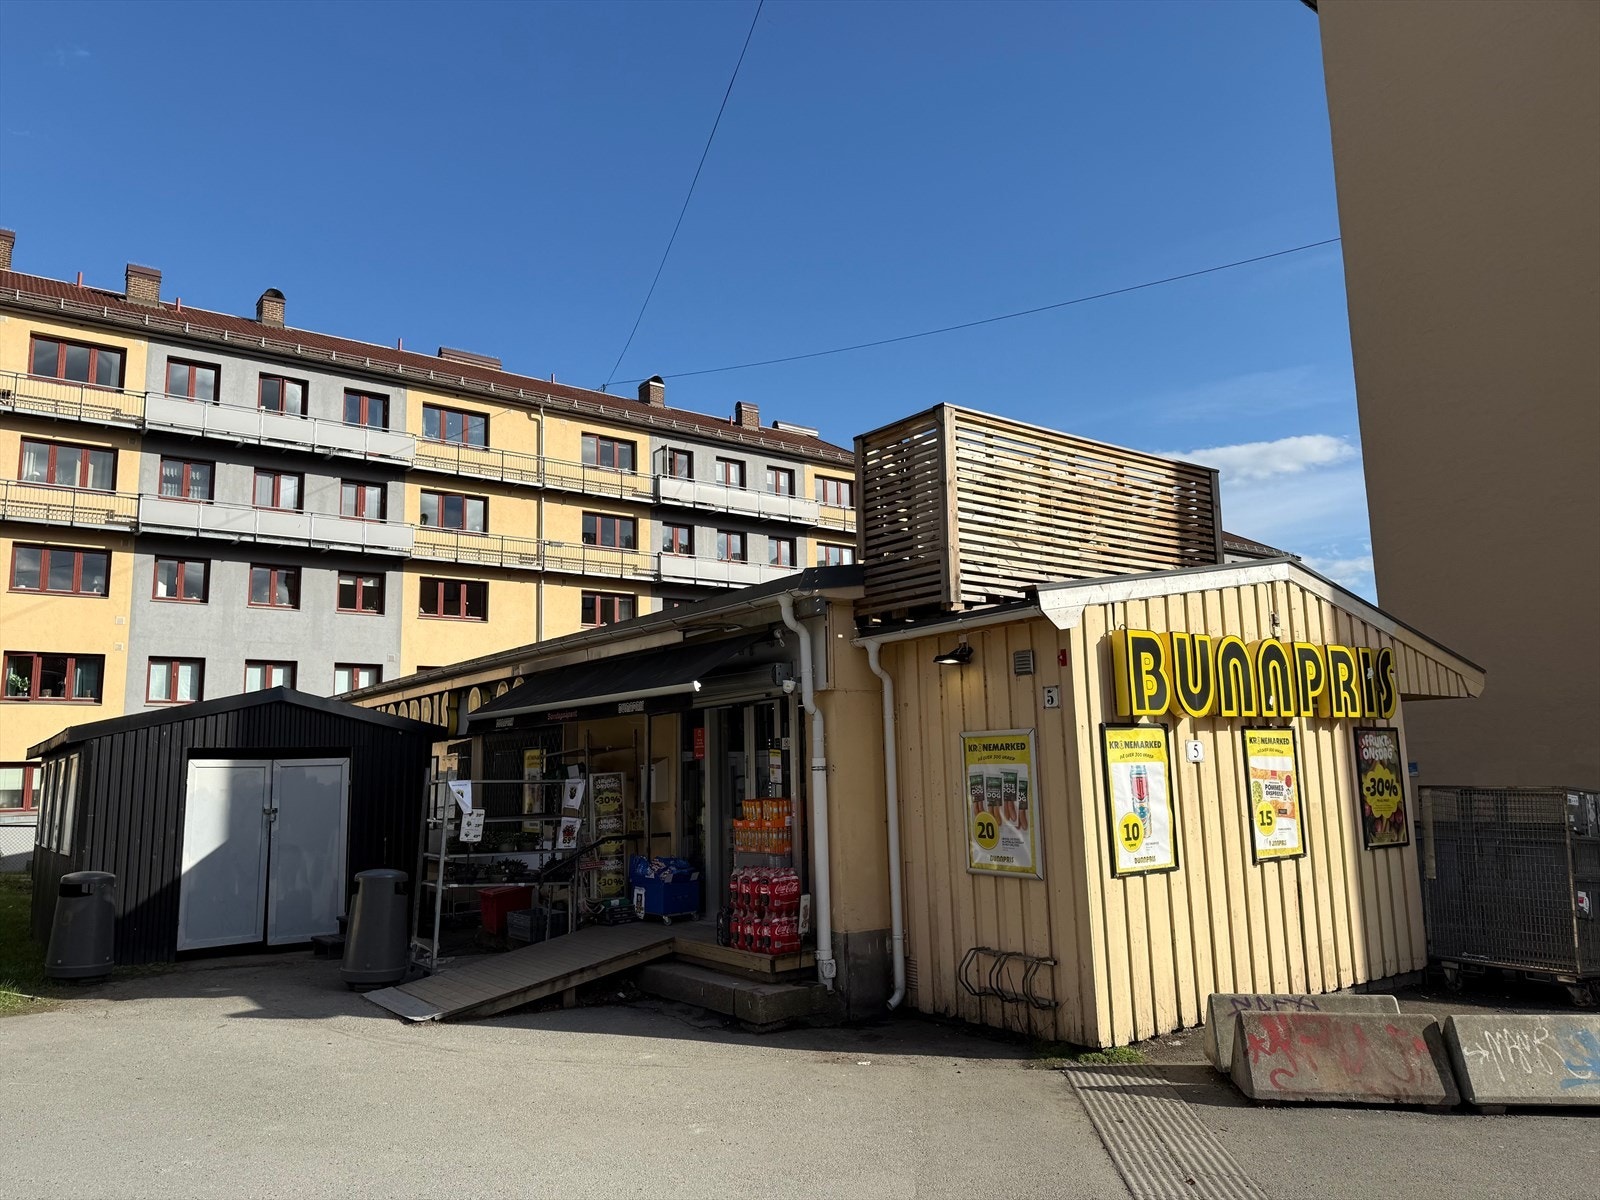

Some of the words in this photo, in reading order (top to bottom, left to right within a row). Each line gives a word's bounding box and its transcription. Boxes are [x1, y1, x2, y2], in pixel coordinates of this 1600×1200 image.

[1124, 629, 1396, 719] BUNNPRIS
[1046, 689, 1054, 706] 5
[1193, 743, 1200, 758] 5
[1362, 747, 1393, 760] ONSDAG
[1366, 778, 1398, 797] -30%
[1259, 810, 1273, 826] 15
[977, 822, 995, 840] 20
[1124, 823, 1139, 841] 10
